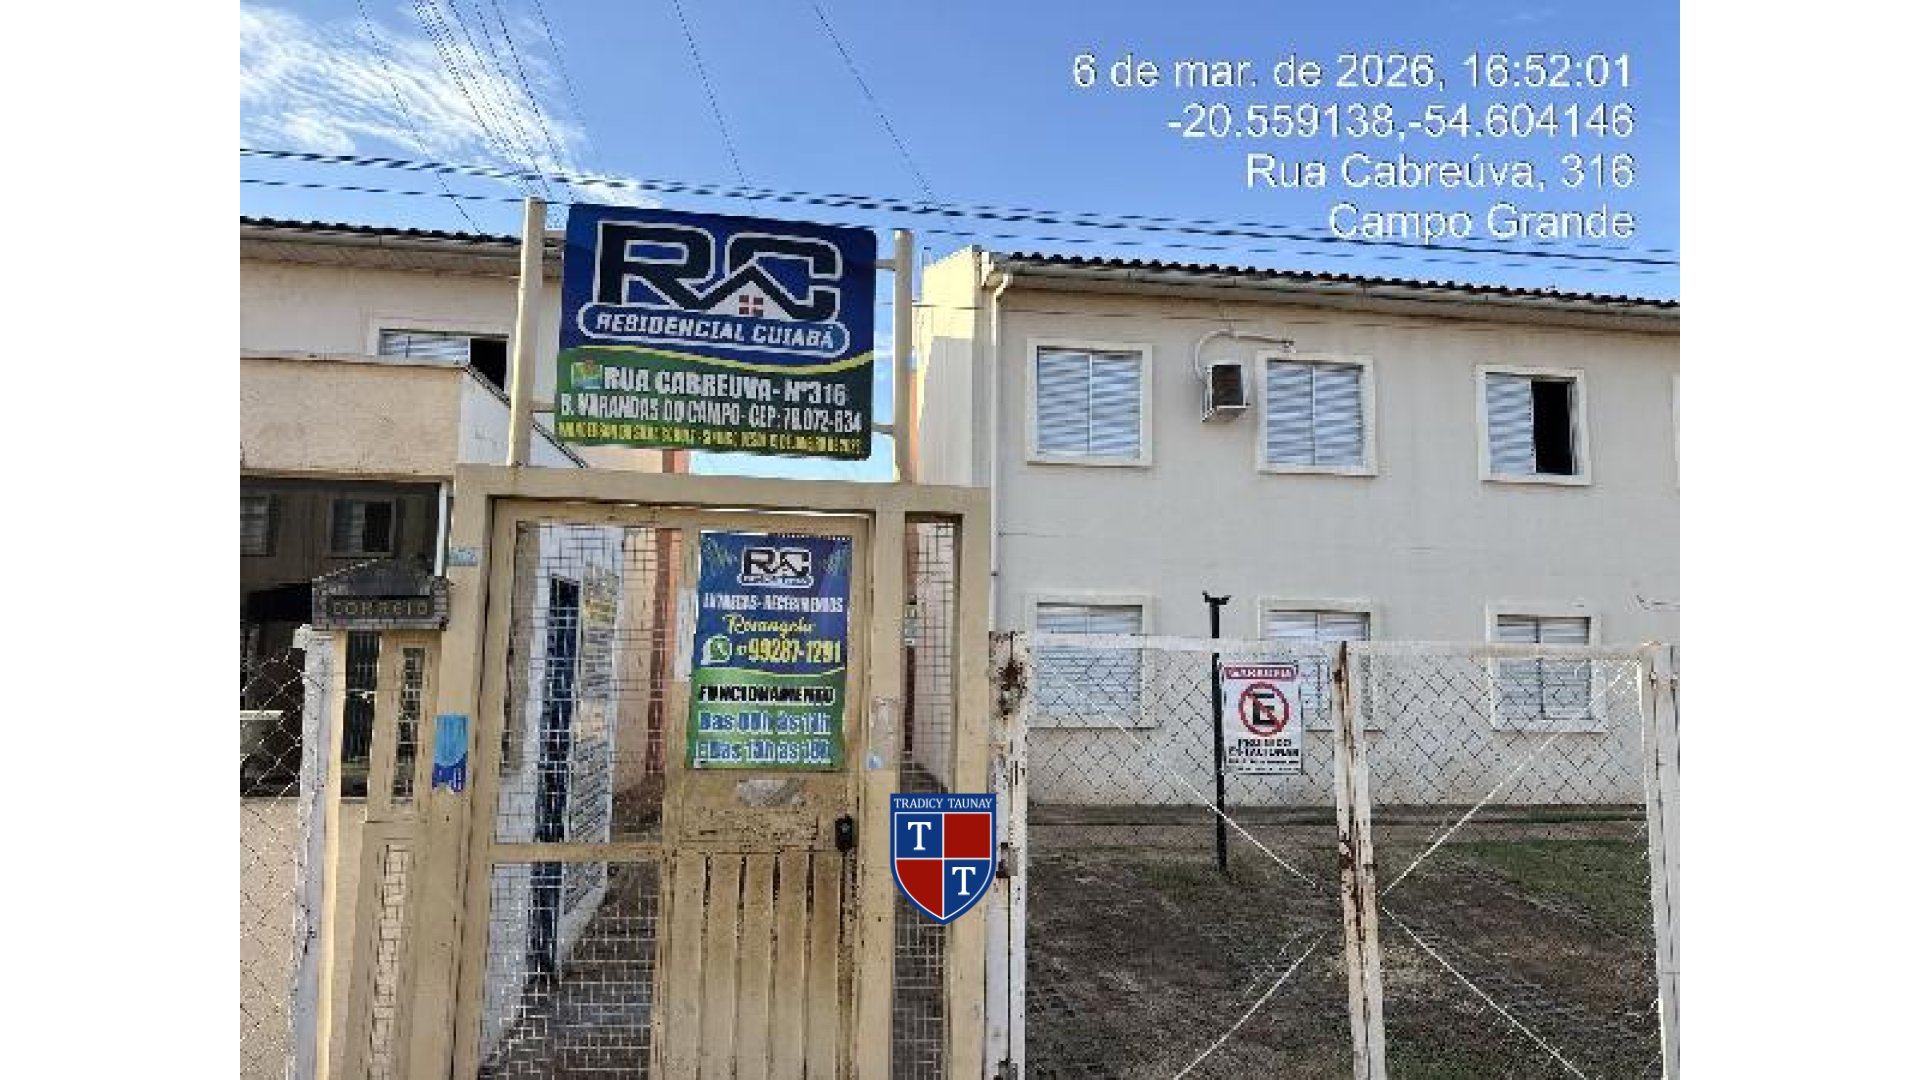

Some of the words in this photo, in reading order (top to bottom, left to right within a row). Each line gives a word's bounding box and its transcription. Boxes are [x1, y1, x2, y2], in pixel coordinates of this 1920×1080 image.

[593, 221, 843, 322] RC
[596, 312, 745, 343] RESIDENCIAL
[751, 323, 835, 350] CUIABÁ
[603, 366, 650, 392] RUA
[560, 393, 574, 416] B.
[664, 399, 685, 423] DO
[741, 546, 812, 577] RC
